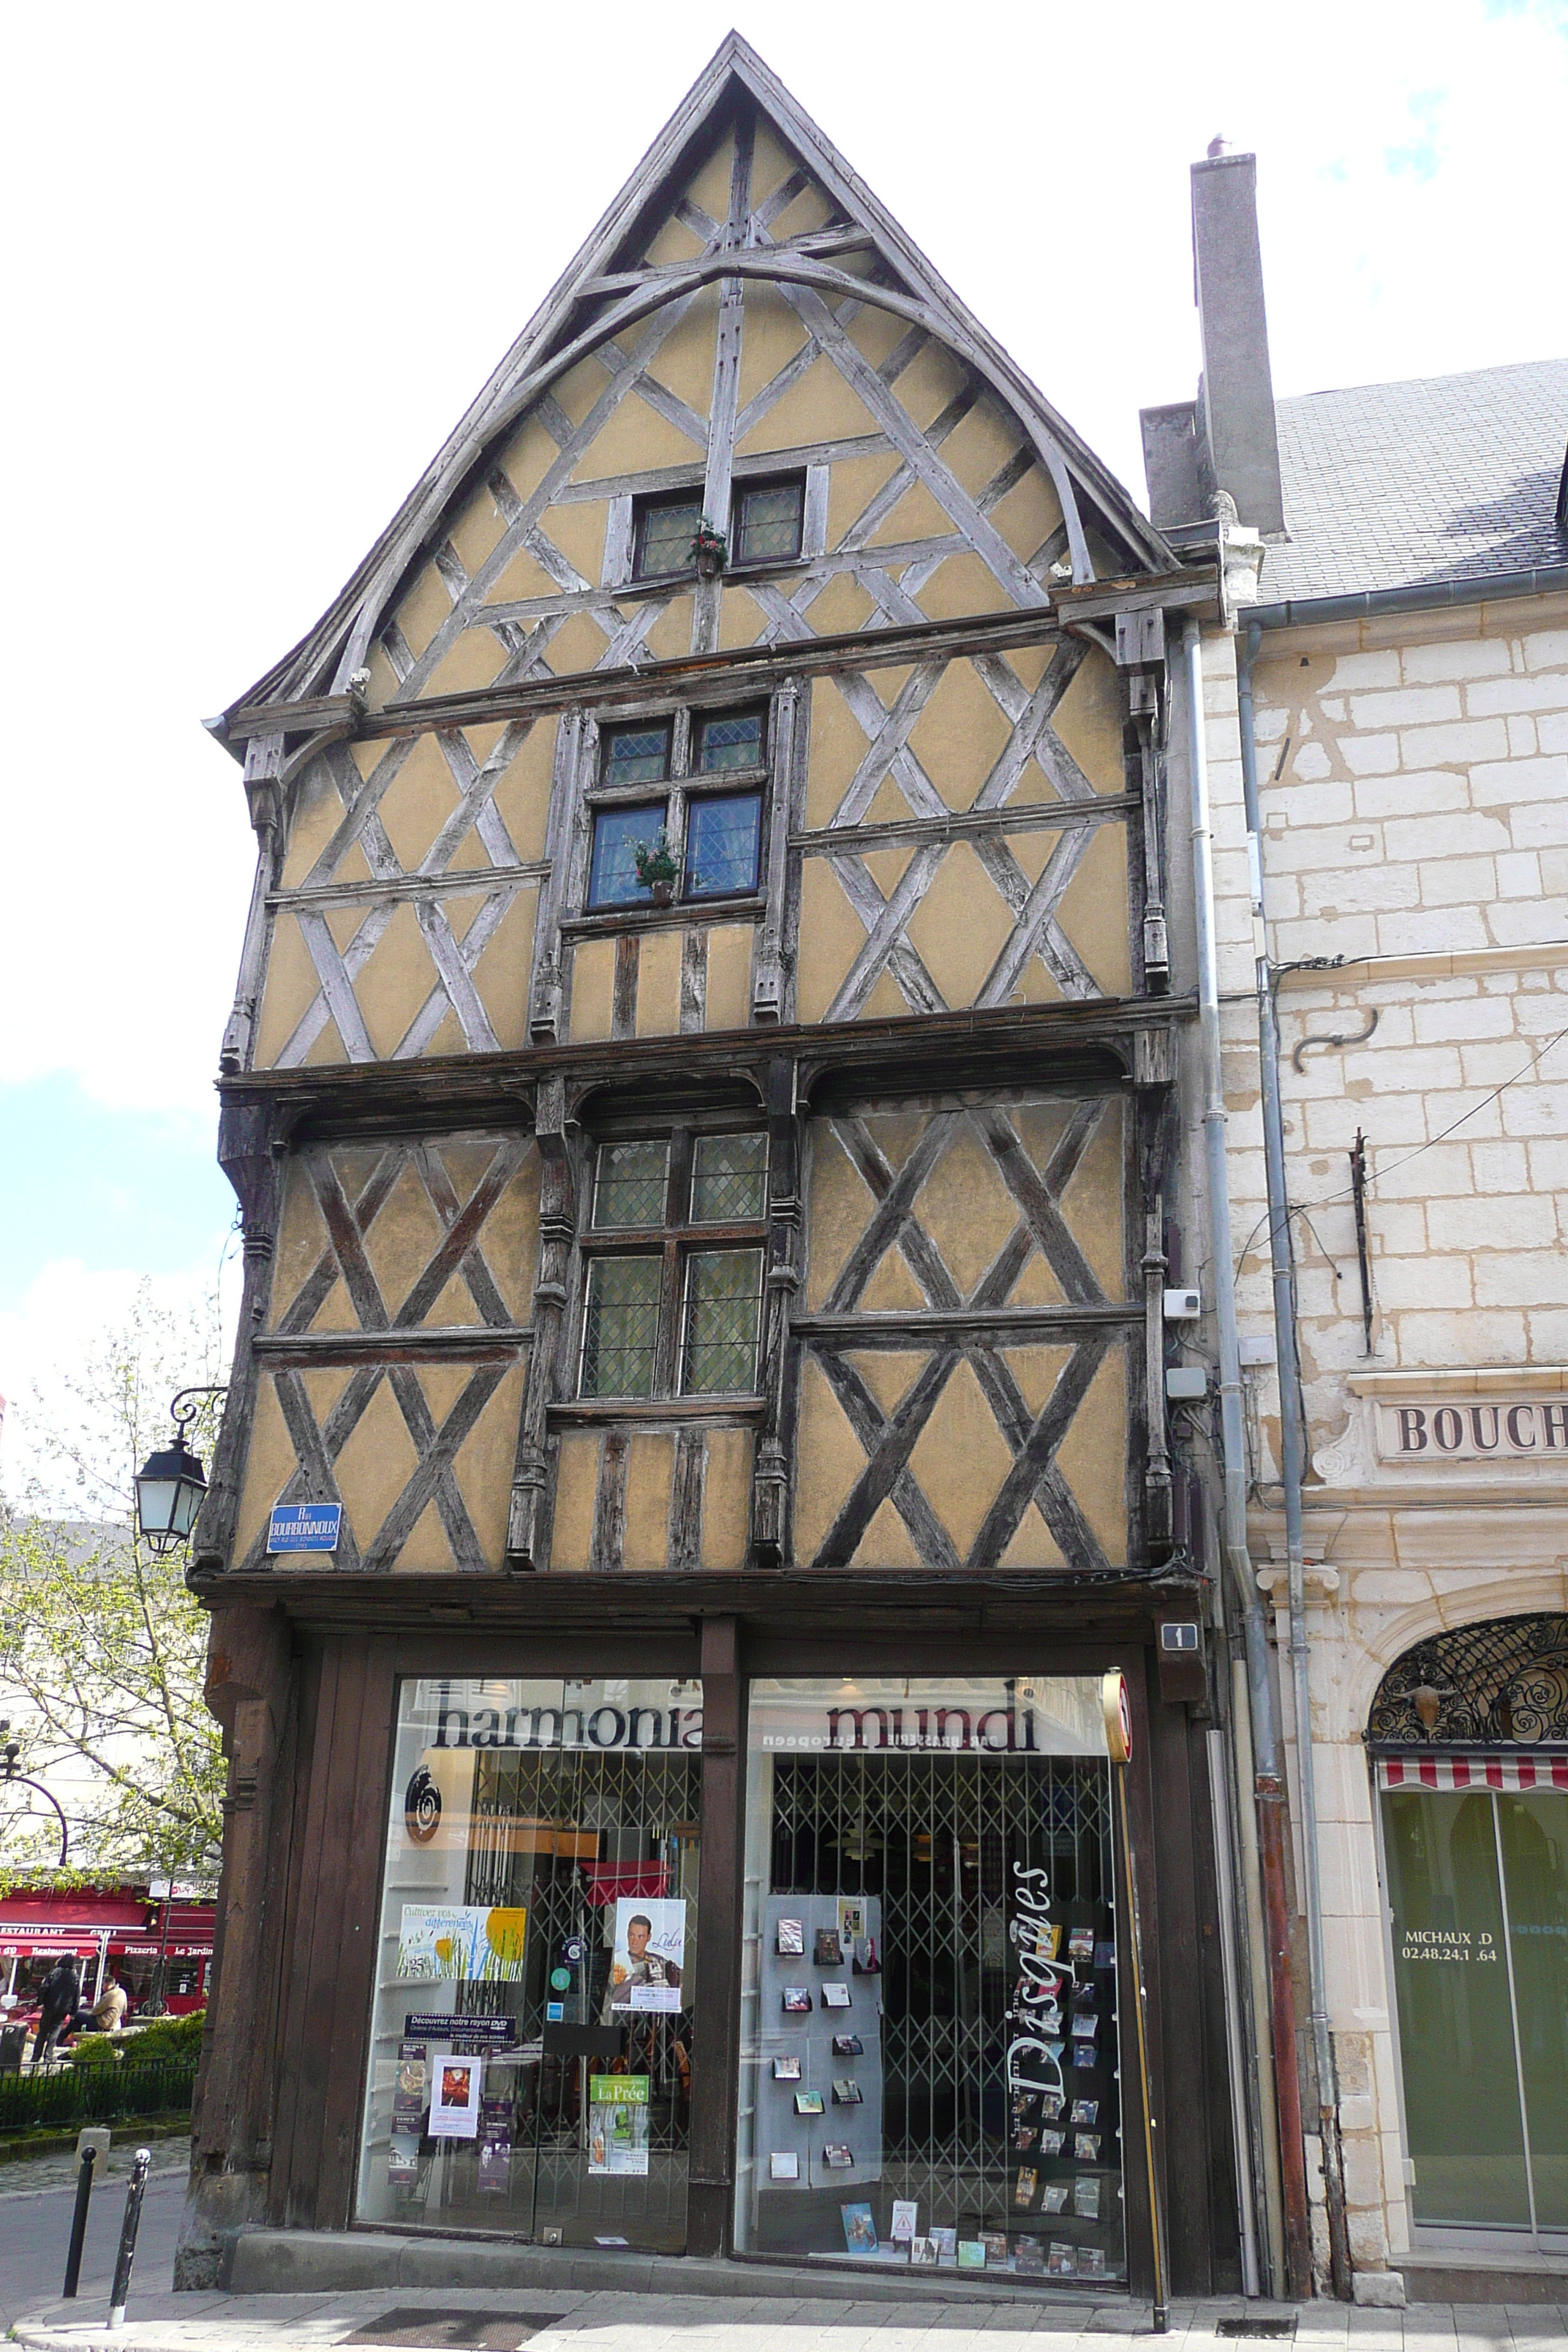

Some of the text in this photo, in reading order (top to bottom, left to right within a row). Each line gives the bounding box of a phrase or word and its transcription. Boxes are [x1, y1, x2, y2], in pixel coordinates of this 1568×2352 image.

[271, 1520, 338, 1536] BOURBONNOUX
[1175, 1627, 1183, 1647] 1
[823, 1679, 1041, 1752] mundi
[1406, 1931, 1471, 1945] MICHAUX
[124, 1945, 158, 1954] Pizzeria
[1005, 1861, 1076, 2107] Disques
[411, 2016, 448, 2024] Découvrez
[598, 2084, 644, 2100] La Prée
